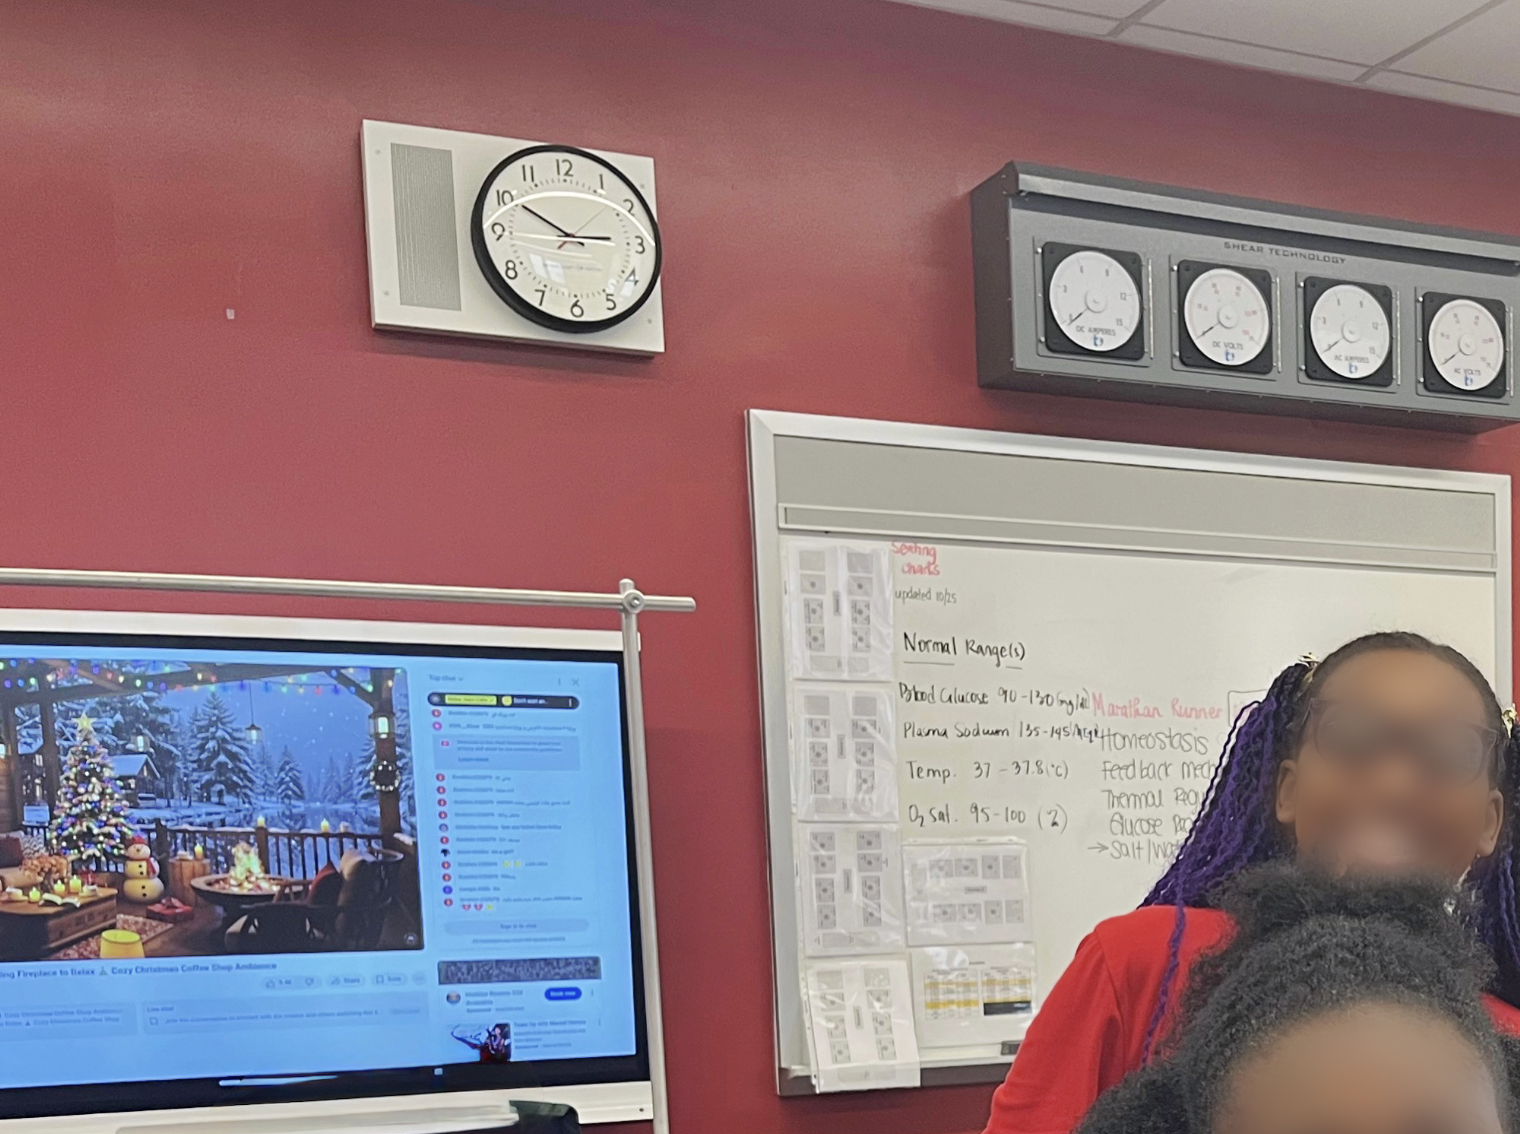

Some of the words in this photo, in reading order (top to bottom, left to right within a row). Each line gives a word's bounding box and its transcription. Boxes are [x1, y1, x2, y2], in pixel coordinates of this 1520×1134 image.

[521, 164, 536, 183] 11
[555, 158, 575, 178] 12
[598, 173, 606, 190] 1
[496, 189, 515, 207] 10
[622, 198, 636, 217] 2
[491, 221, 506, 241] 9
[634, 235, 646, 254] 3
[1223, 241, 1264, 254] SHEAR
[1268, 246, 1347, 265] TECHNOLOGY
[504, 259, 519, 280] 8
[624, 268, 640, 287] 4
[534, 288, 548, 307] 7
[605, 293, 618, 311] 5
[570, 298, 585, 318] 6
[895, 586, 932, 604] updated
[936, 588, 957, 606] 10/25
[904, 632, 957, 656] Normal
[965, 638, 1026, 668] Range(s)
[899, 682, 935, 705] Blood
[939, 686, 990, 705] Glucose
[1170, 697, 1223, 719] Runner
[903, 721, 949, 739] Plasma
[954, 721, 1010, 738] Sodium
[1100, 727, 1209, 756] Homeostasis
[905, 760, 957, 784] Temp.
[973, 761, 991, 779] 37
[1101, 758, 1173, 782] Feedback
[1181, 759, 1216, 780] mech
[1101, 788, 1165, 810] Thermal
[1174, 787, 1205, 815] Reg
[929, 803, 959, 824] Sat.
[970, 802, 1026, 824] 95-100
[1109, 812, 1163, 837] Glucose
[0, 970, 15, 979] ing
[17, 969, 57, 978] Fireplace
[60, 968, 69, 976] to
[111, 966, 133, 976] Cozy
[134, 964, 179, 974] Christmas
[181, 963, 209, 973] Coffee
